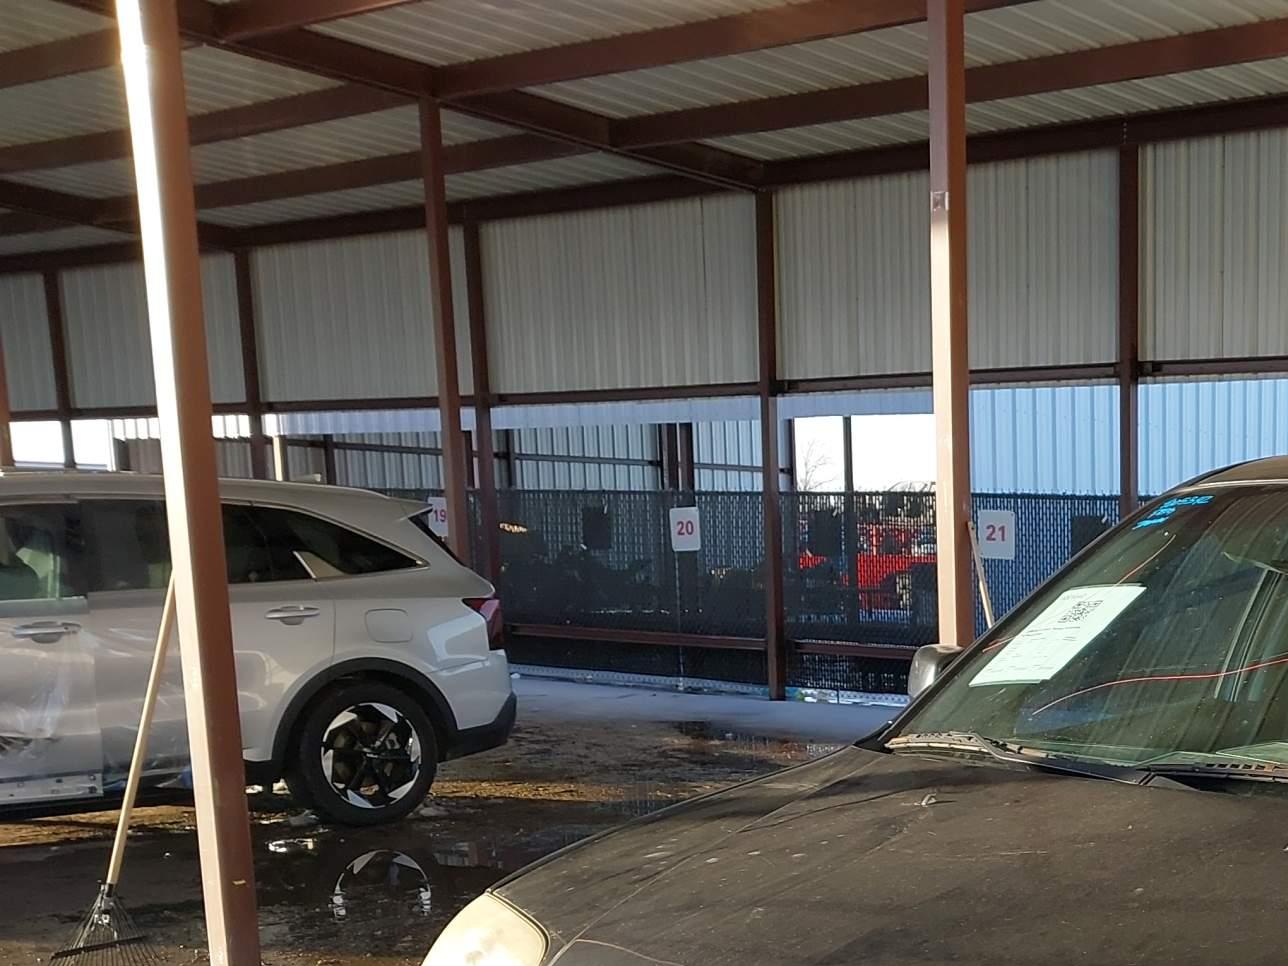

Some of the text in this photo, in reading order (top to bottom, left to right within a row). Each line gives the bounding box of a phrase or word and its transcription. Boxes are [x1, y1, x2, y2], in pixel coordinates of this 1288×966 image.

[434, 509, 447, 522] 19
[675, 520, 695, 536] 20
[985, 523, 1006, 542] 21
